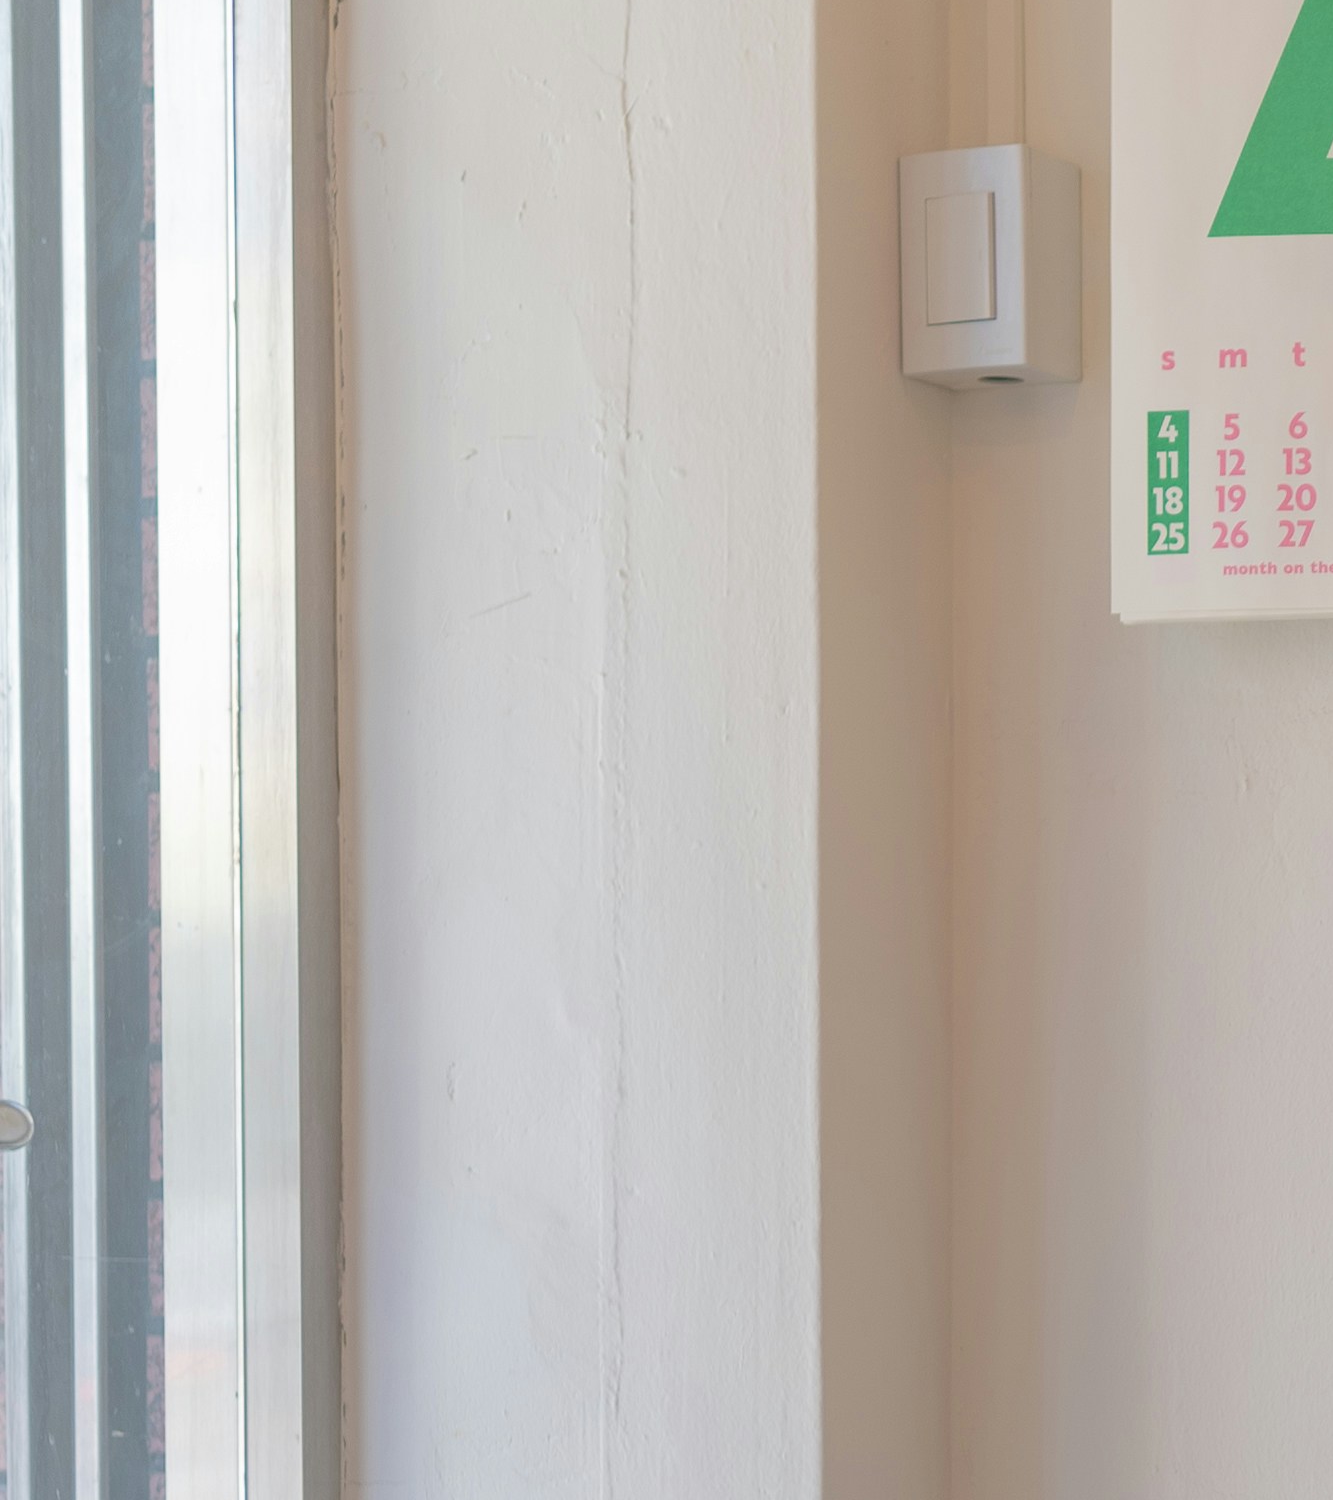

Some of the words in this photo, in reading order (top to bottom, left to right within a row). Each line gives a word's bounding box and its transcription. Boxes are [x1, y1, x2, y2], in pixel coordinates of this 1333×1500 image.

[1160, 349, 1177, 372] s
[1218, 345, 1249, 369] m
[1292, 341, 1306, 368] t
[1158, 415, 1179, 443] 4
[1222, 412, 1241, 442] 5
[1288, 410, 1309, 440] 6
[1156, 451, 1179, 479] 11
[1215, 448, 1246, 477] 12
[1282, 447, 1313, 476] 13
[1152, 486, 1184, 515] 18
[1215, 483, 1247, 513] 19
[1277, 482, 1318, 513] 20
[1151, 522, 1185, 552] 25
[1211, 520, 1249, 550] 26
[1279, 518, 1315, 549] 27
[1222, 561, 1277, 576] month
[1283, 563, 1304, 575] on
